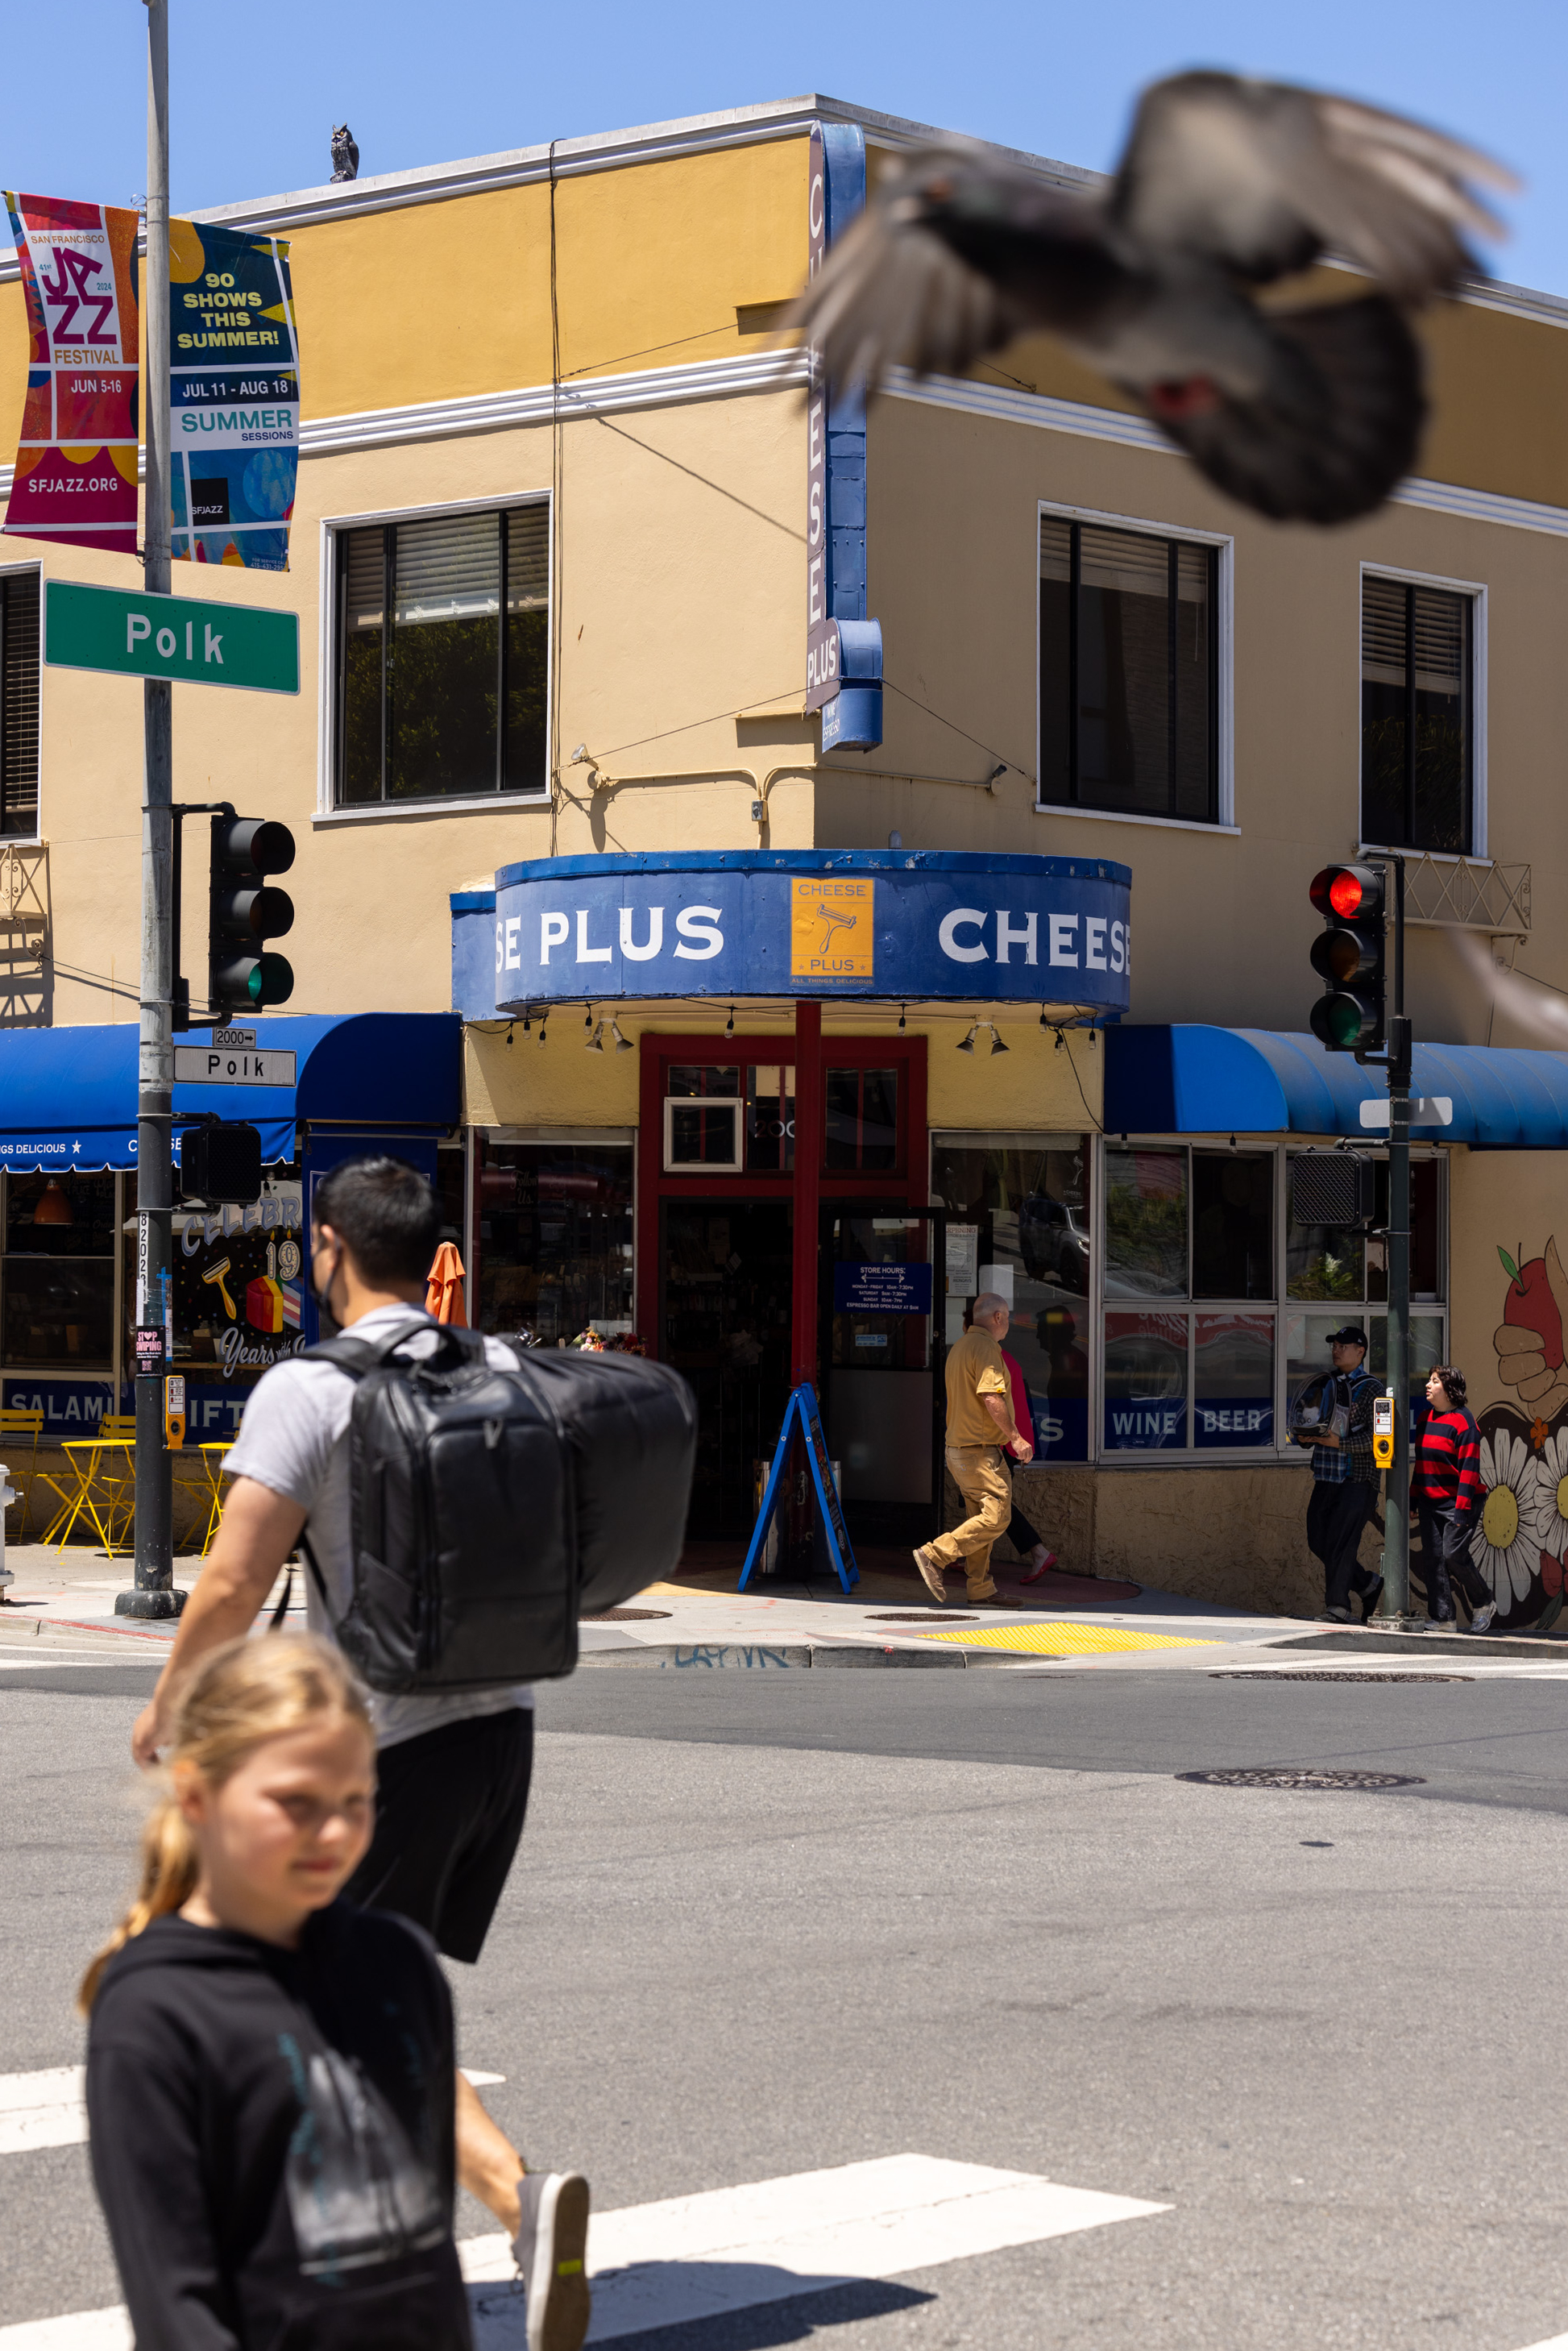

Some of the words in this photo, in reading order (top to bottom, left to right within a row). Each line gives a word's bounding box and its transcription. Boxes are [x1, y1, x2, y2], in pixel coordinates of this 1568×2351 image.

[31, 235, 50, 243] SAN
[52, 235, 105, 243] FRANCISCO
[97, 282, 112, 290] 2024
[205, 273, 234, 288] 90
[41, 247, 117, 344] JAZZ
[183, 292, 263, 308] SHOWS
[201, 312, 251, 327] THIS
[177, 331, 279, 348] SUMMER!
[54, 349, 118, 364] FESTIVAL
[71, 380, 97, 393] JUN
[101, 380, 122, 393] 5-16
[182, 383, 209, 397] JUL
[211, 383, 226, 396] 11
[239, 380, 268, 395] AUG
[272, 380, 288, 393] 18
[181, 409, 292, 433] SUMMER
[242, 430, 293, 441] SESSIONS
[28, 477, 118, 492] SFJAZZ.ORG
[192, 505, 223, 514] SFJAZZ
[127, 613, 224, 664] Polk
[807, 634, 836, 694] PLUS
[799, 884, 866, 895] CHEESE
[539, 905, 724, 966] PLUS
[811, 959, 854, 970] PLUS
[217, 1030, 244, 1045] 2000
[208, 1054, 264, 1077] Polk
[16, 1144, 66, 1153] DELICIOUS
[181, 1197, 302, 1256] CELEBR
[266, 1240, 301, 1281] 19
[138, 1331, 158, 1341] STP
[219, 1327, 275, 1377] Years
[190, 1399, 247, 1428] IFT
[1203, 1409, 1261, 1433] BEER
[1112, 1412, 1176, 1435] WINE
